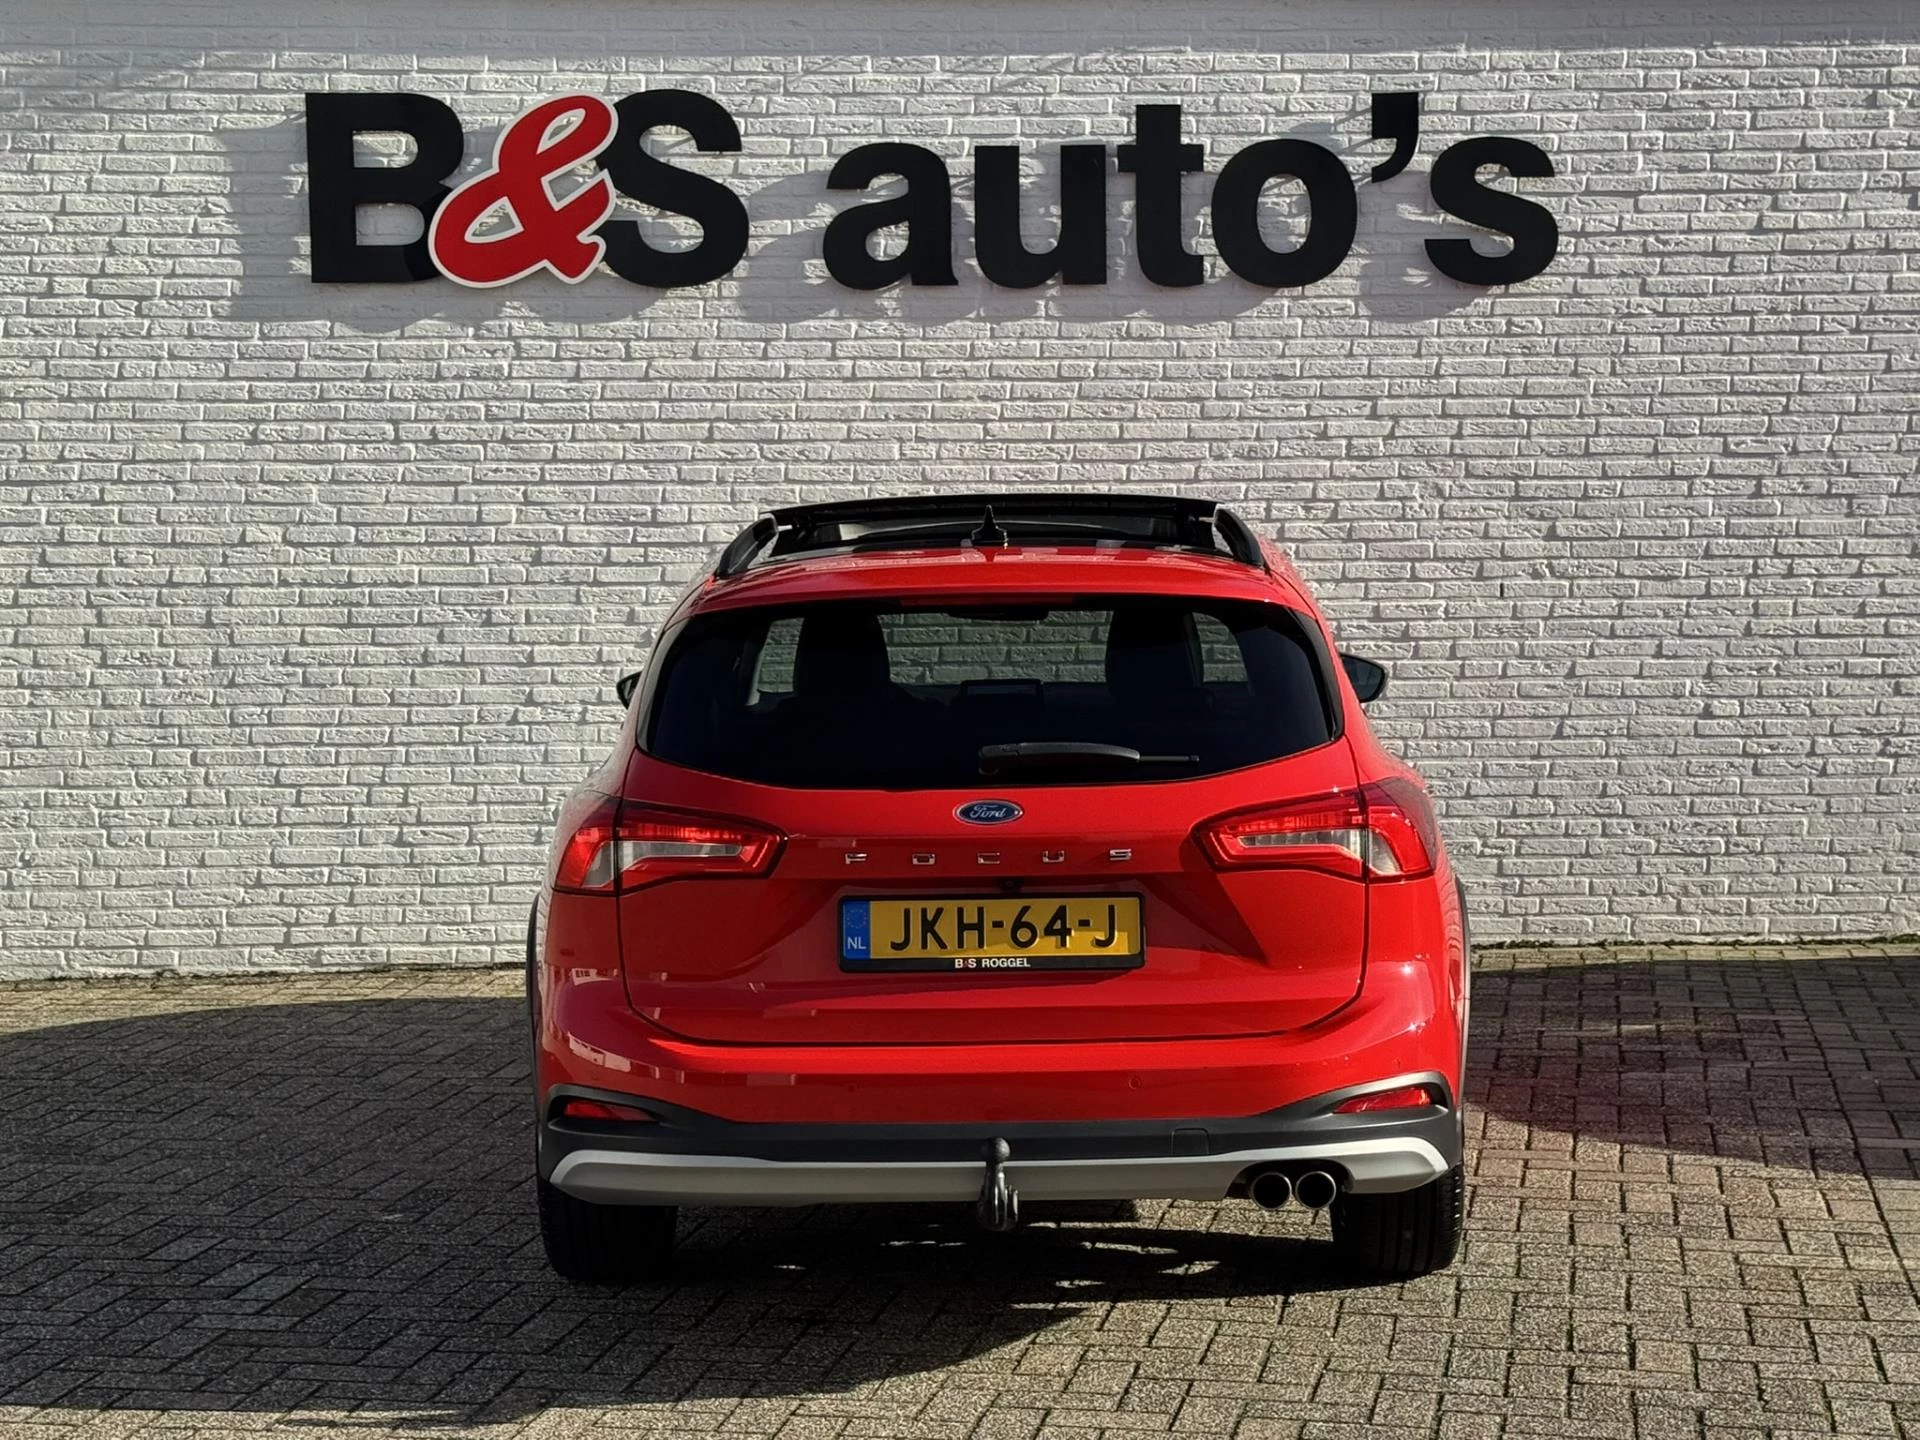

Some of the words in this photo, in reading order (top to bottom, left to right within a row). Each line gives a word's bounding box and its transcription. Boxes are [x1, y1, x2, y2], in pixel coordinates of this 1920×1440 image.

[305, 89, 749, 290] B&S
[824, 91, 1559, 290] auto's
[968, 805, 1006, 819] Ford
[845, 849, 1132, 864] FOCUS
[890, 904, 1117, 951] JKH-64-J
[847, 937, 867, 950] NL
[981, 957, 1031, 969] ROGGEL
